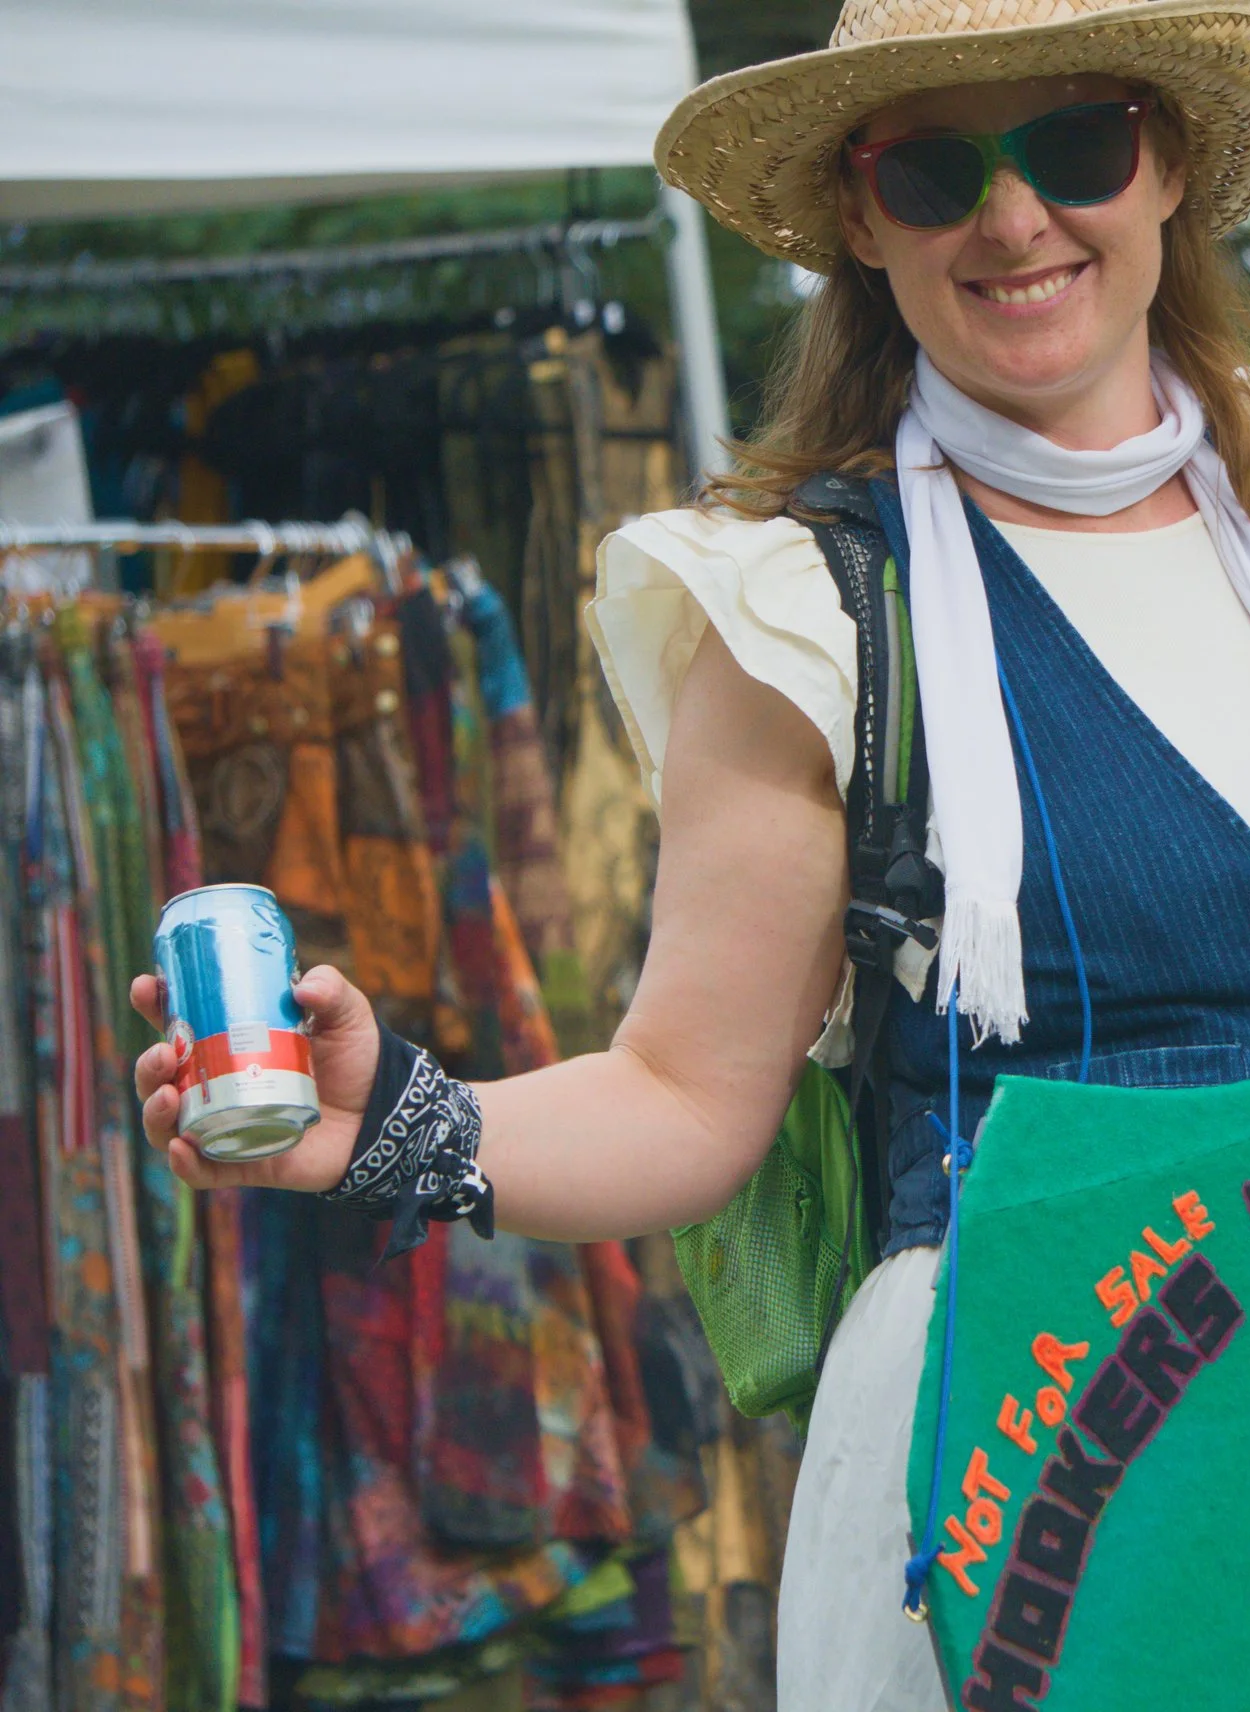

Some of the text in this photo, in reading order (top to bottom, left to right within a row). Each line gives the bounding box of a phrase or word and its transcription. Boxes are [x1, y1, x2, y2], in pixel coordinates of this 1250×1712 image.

[937, 1190, 1215, 1597] NOT FOR SALE
[961, 1252, 1245, 1712] HOOKERS
